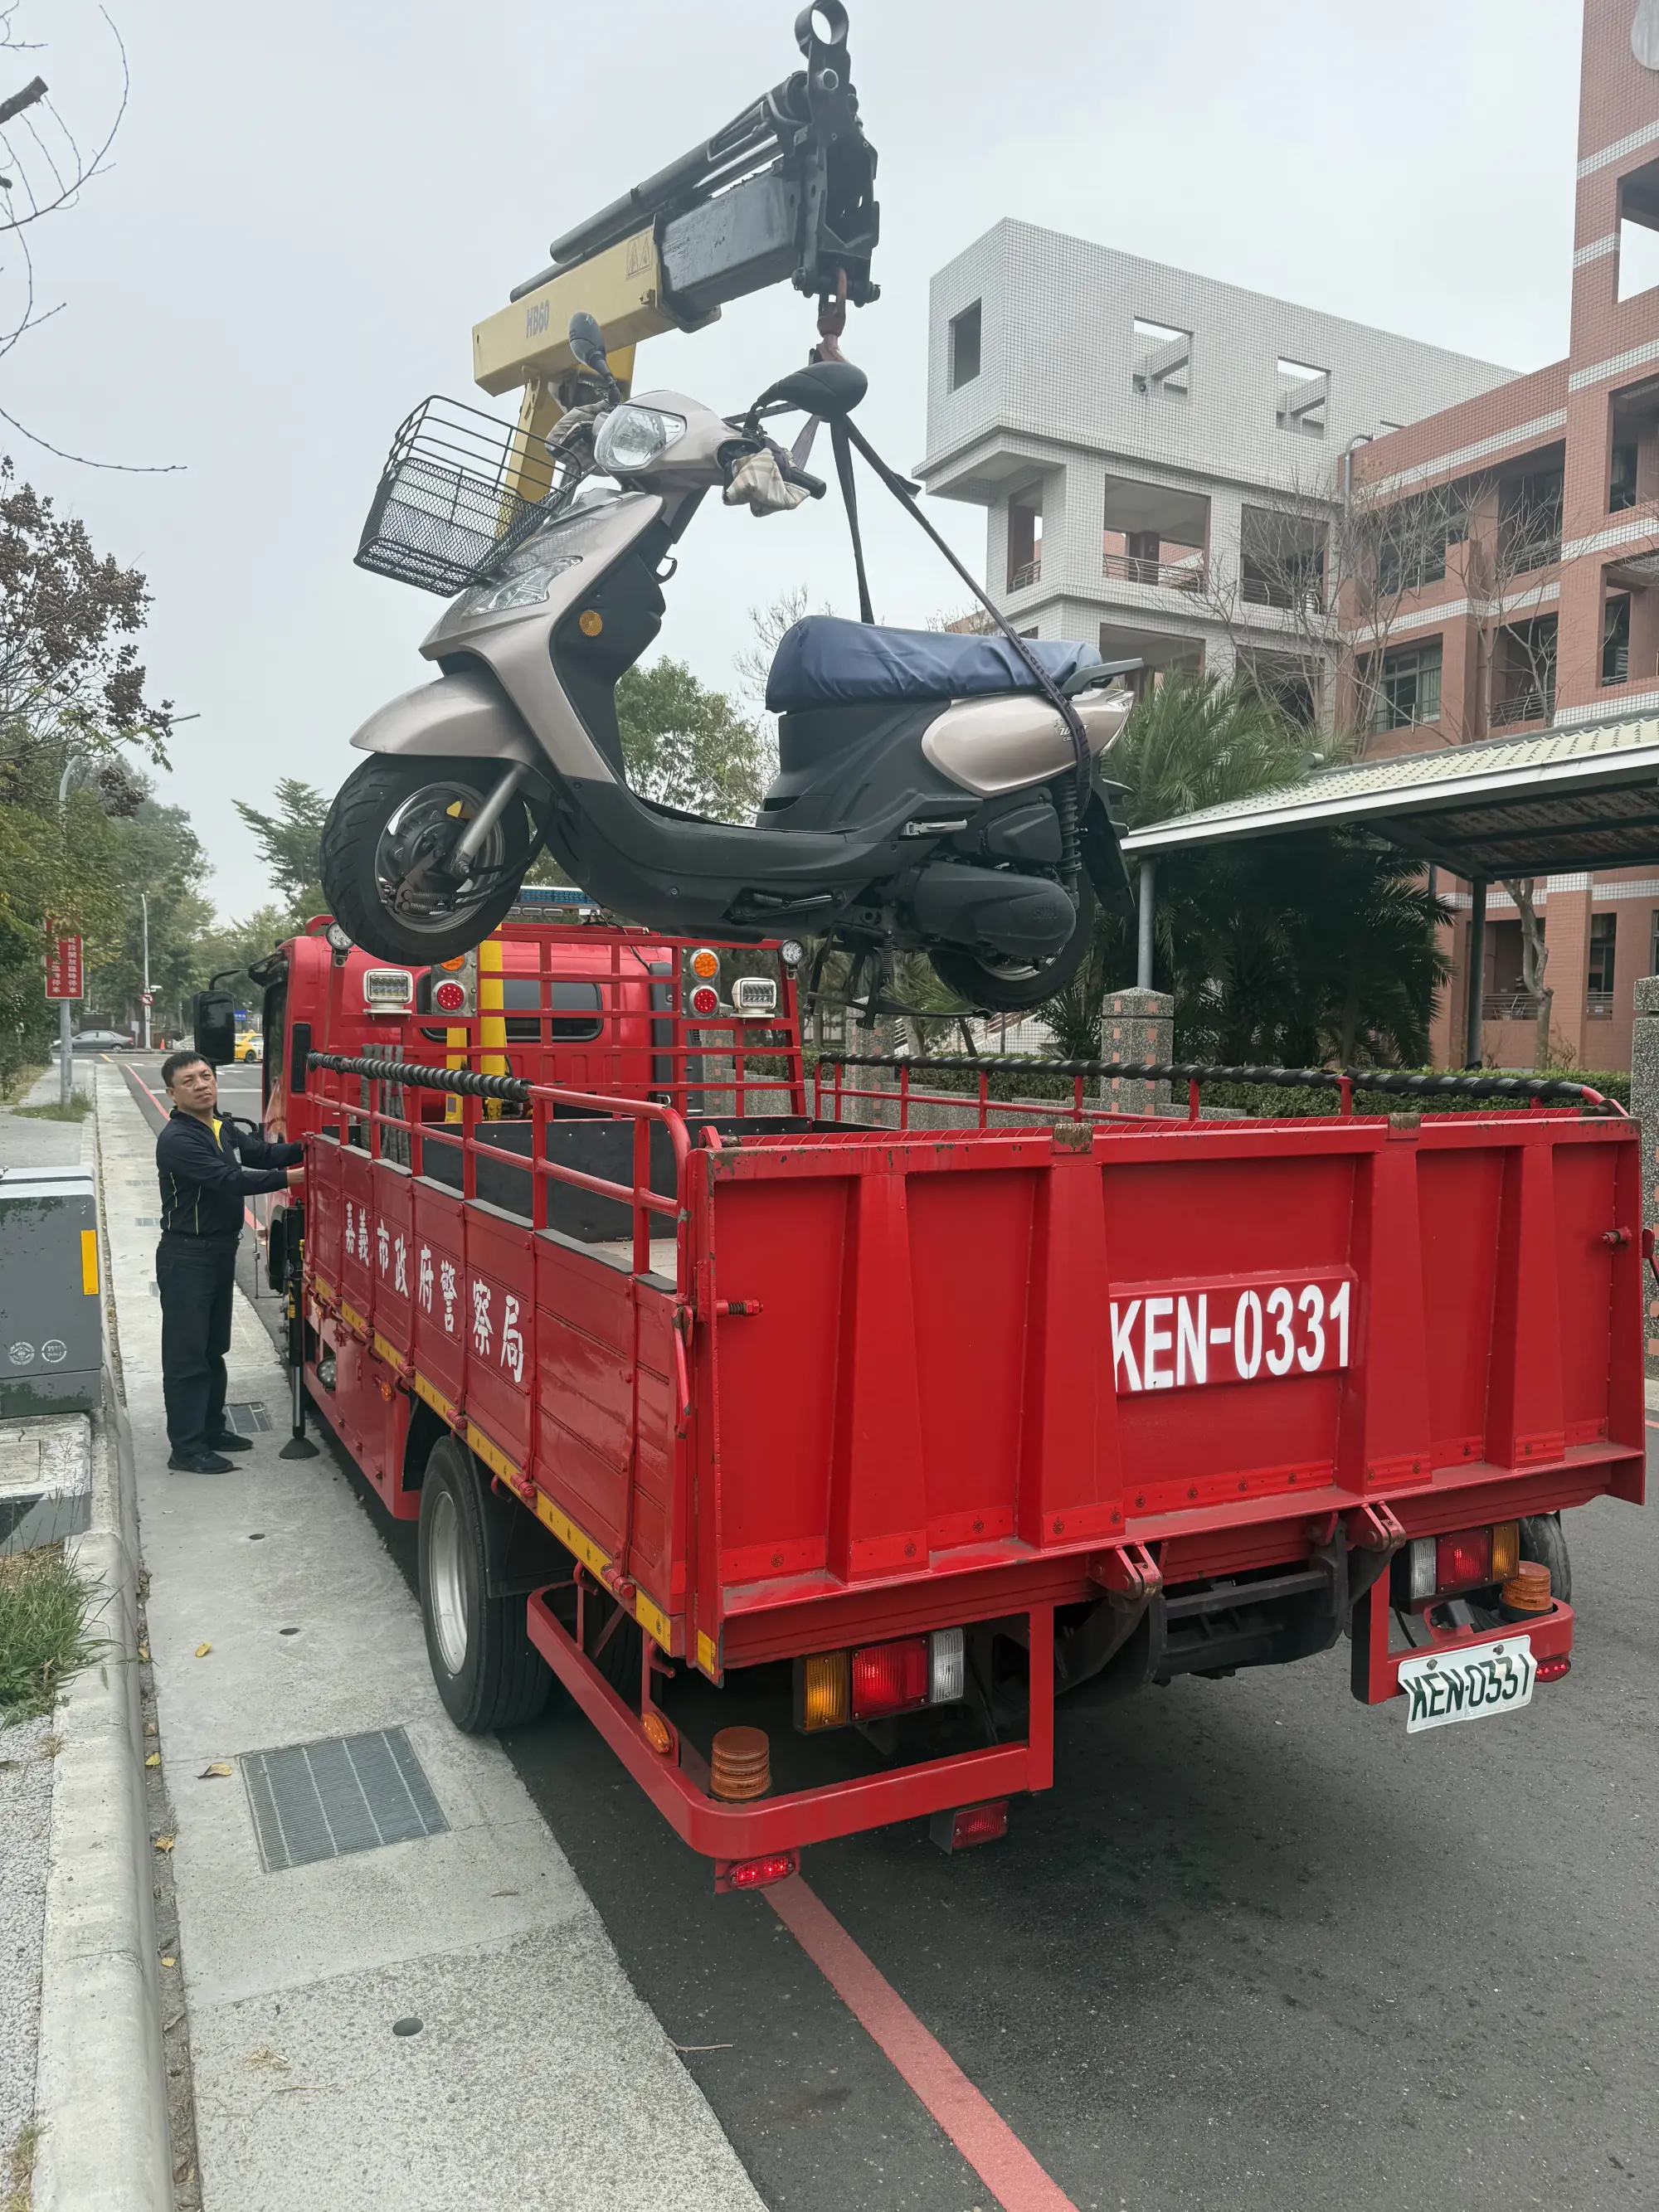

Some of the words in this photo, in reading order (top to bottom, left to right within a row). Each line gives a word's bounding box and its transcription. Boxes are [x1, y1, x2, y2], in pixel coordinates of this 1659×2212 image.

[526, 299, 550, 338] HB60
[345, 1201, 524, 1383] 嘉義市政府警察局
[1110, 1281, 1350, 1392] KEN-0331
